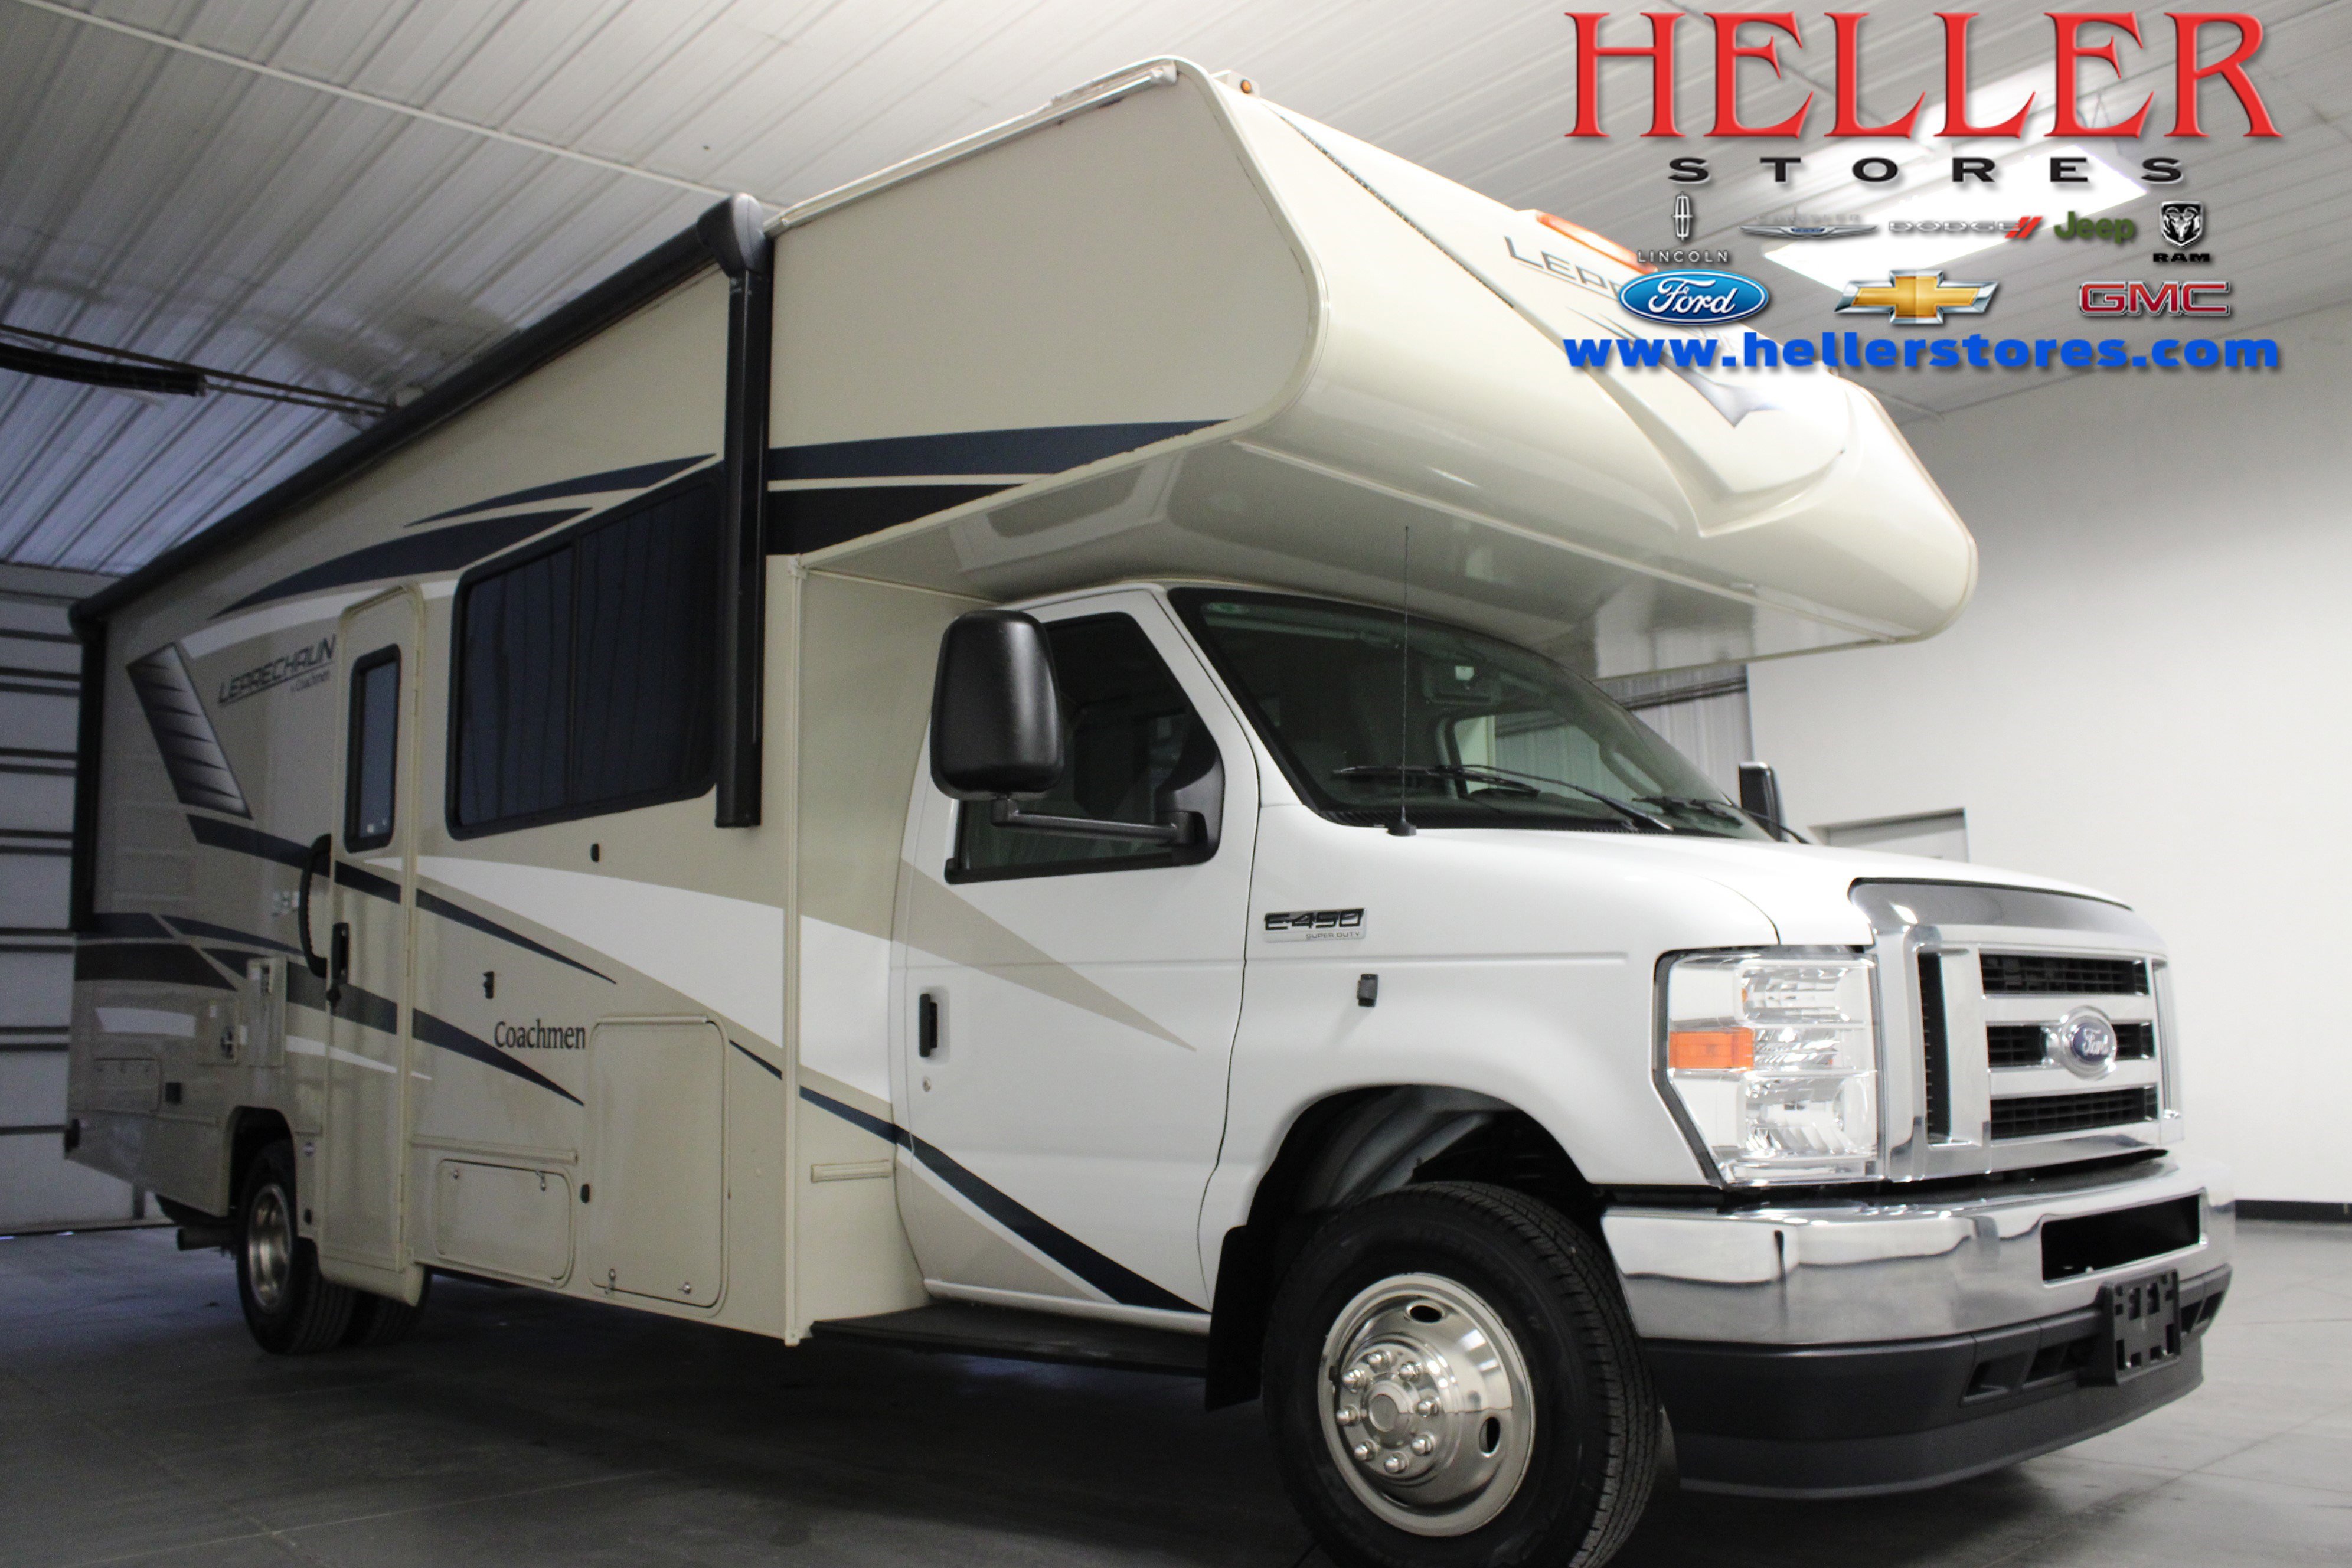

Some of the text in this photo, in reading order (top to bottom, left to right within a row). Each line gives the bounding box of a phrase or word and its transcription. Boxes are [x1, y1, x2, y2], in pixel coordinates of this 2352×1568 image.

[218, 633, 335, 704] LEPRECHAUN
[494, 1018, 586, 1050] Coachmen
[2082, 1028, 2108, 1056] Ford
